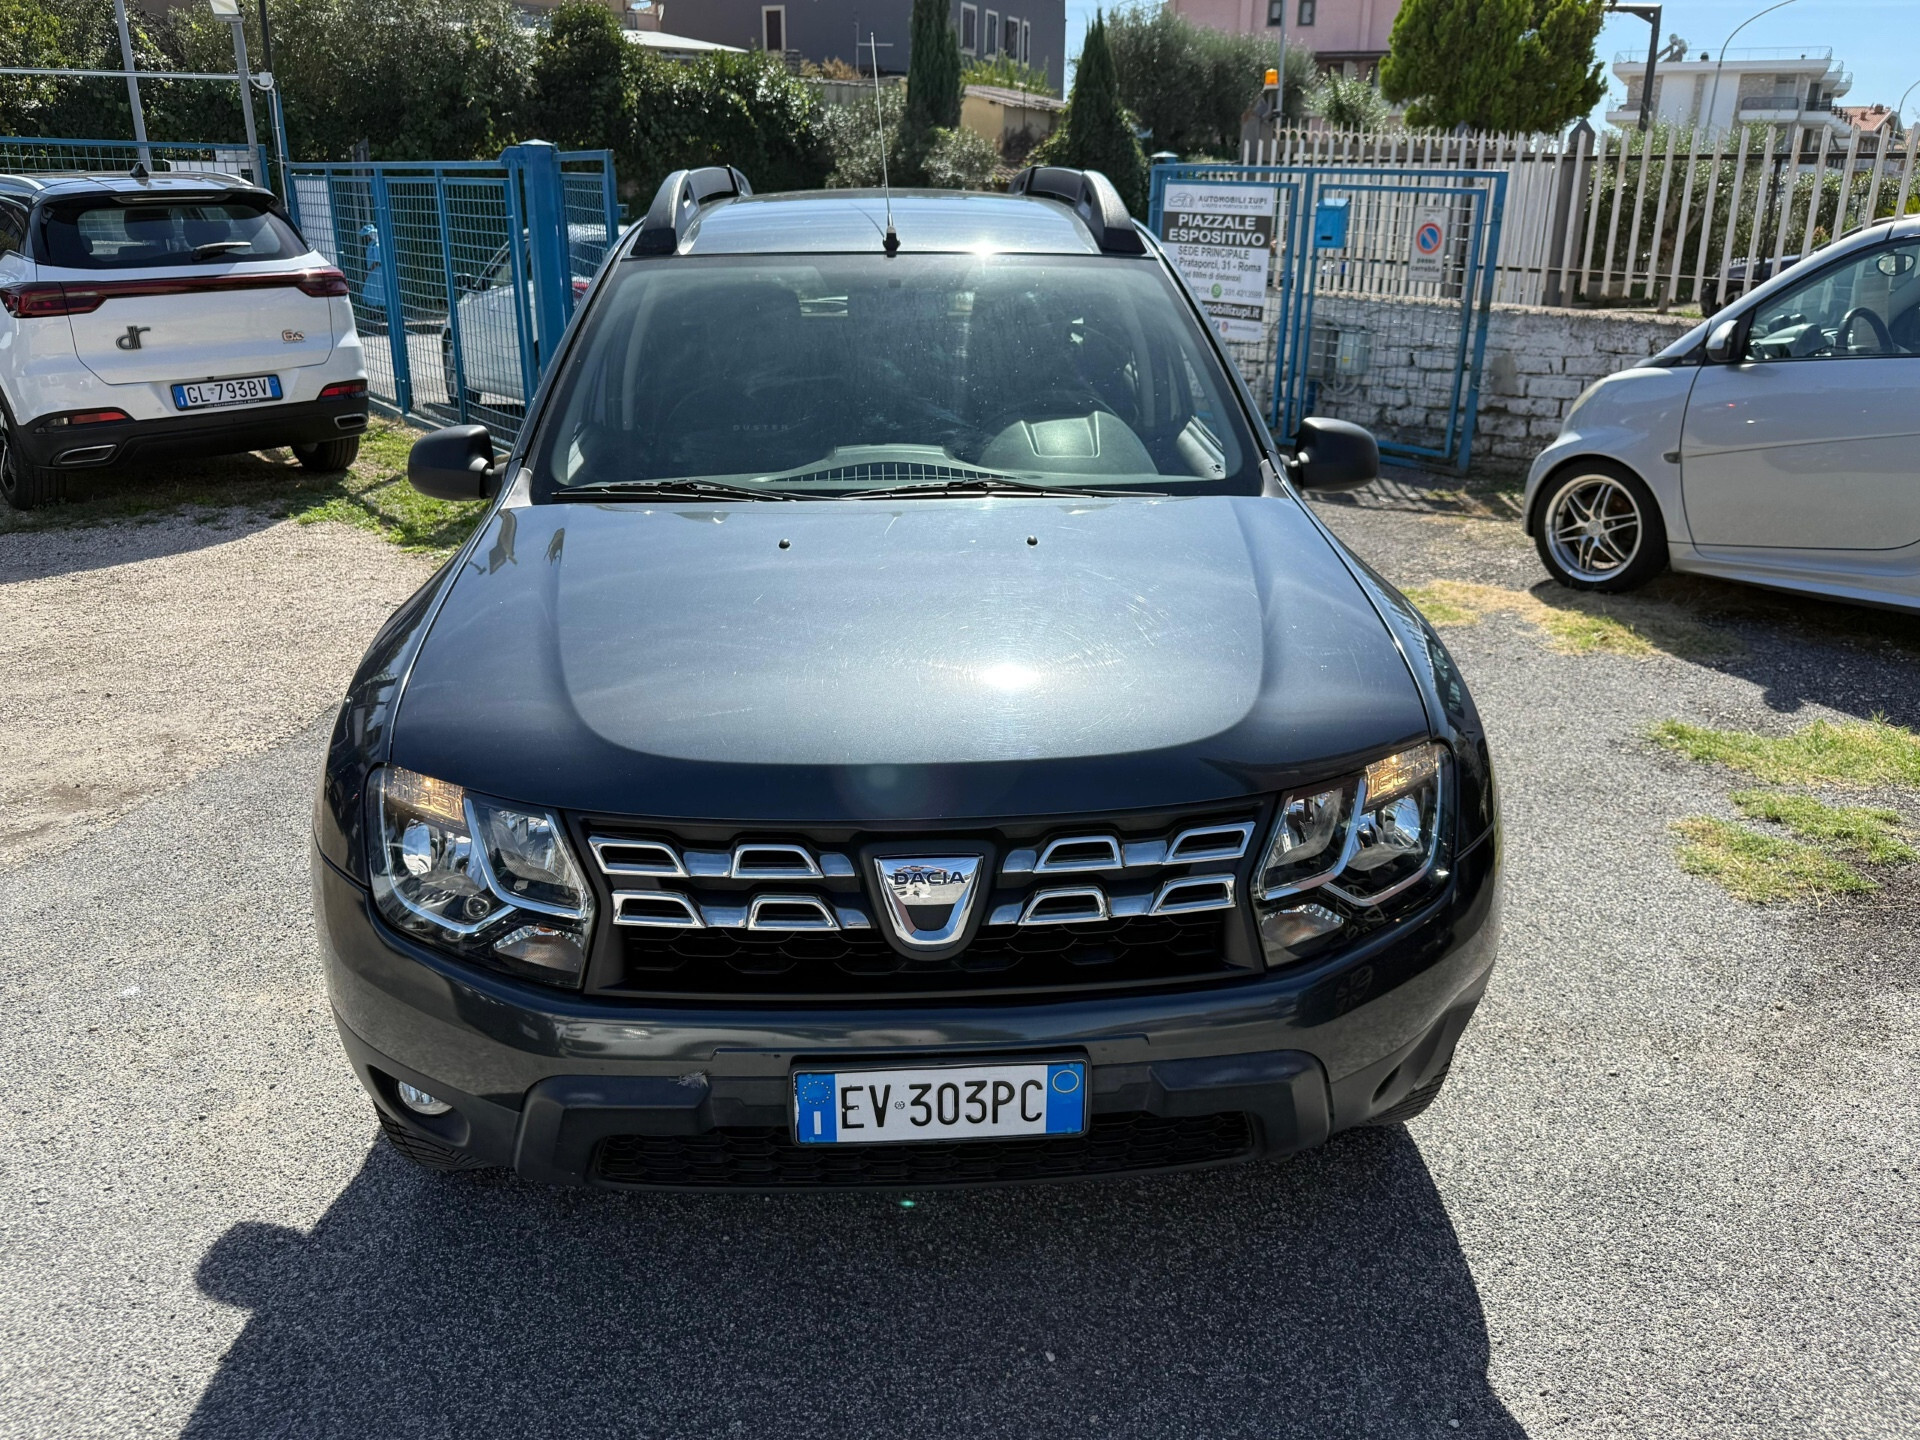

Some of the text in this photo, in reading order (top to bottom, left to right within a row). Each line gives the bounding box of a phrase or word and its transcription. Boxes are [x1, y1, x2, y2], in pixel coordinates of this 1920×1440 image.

[1198, 195, 1267, 205] AUTOMOBILI ZUPI
[1178, 213, 1257, 230] PIAZZALE
[1168, 228, 1266, 247] ESPOSITIVO
[1178, 246, 1250, 260] SEDE PRINCIPALE
[1221, 261, 1231, 271] 31
[1238, 262, 1262, 273] Roma
[1203, 303, 1260, 319] mobilizupi.it
[186, 385, 211, 404] GL
[214, 379, 267, 401] 793BV
[732, 424, 790, 432] DUSTER
[893, 871, 966, 885] DACIA
[840, 1084, 891, 1130] EV
[909, 1079, 1043, 1128] 303PC
